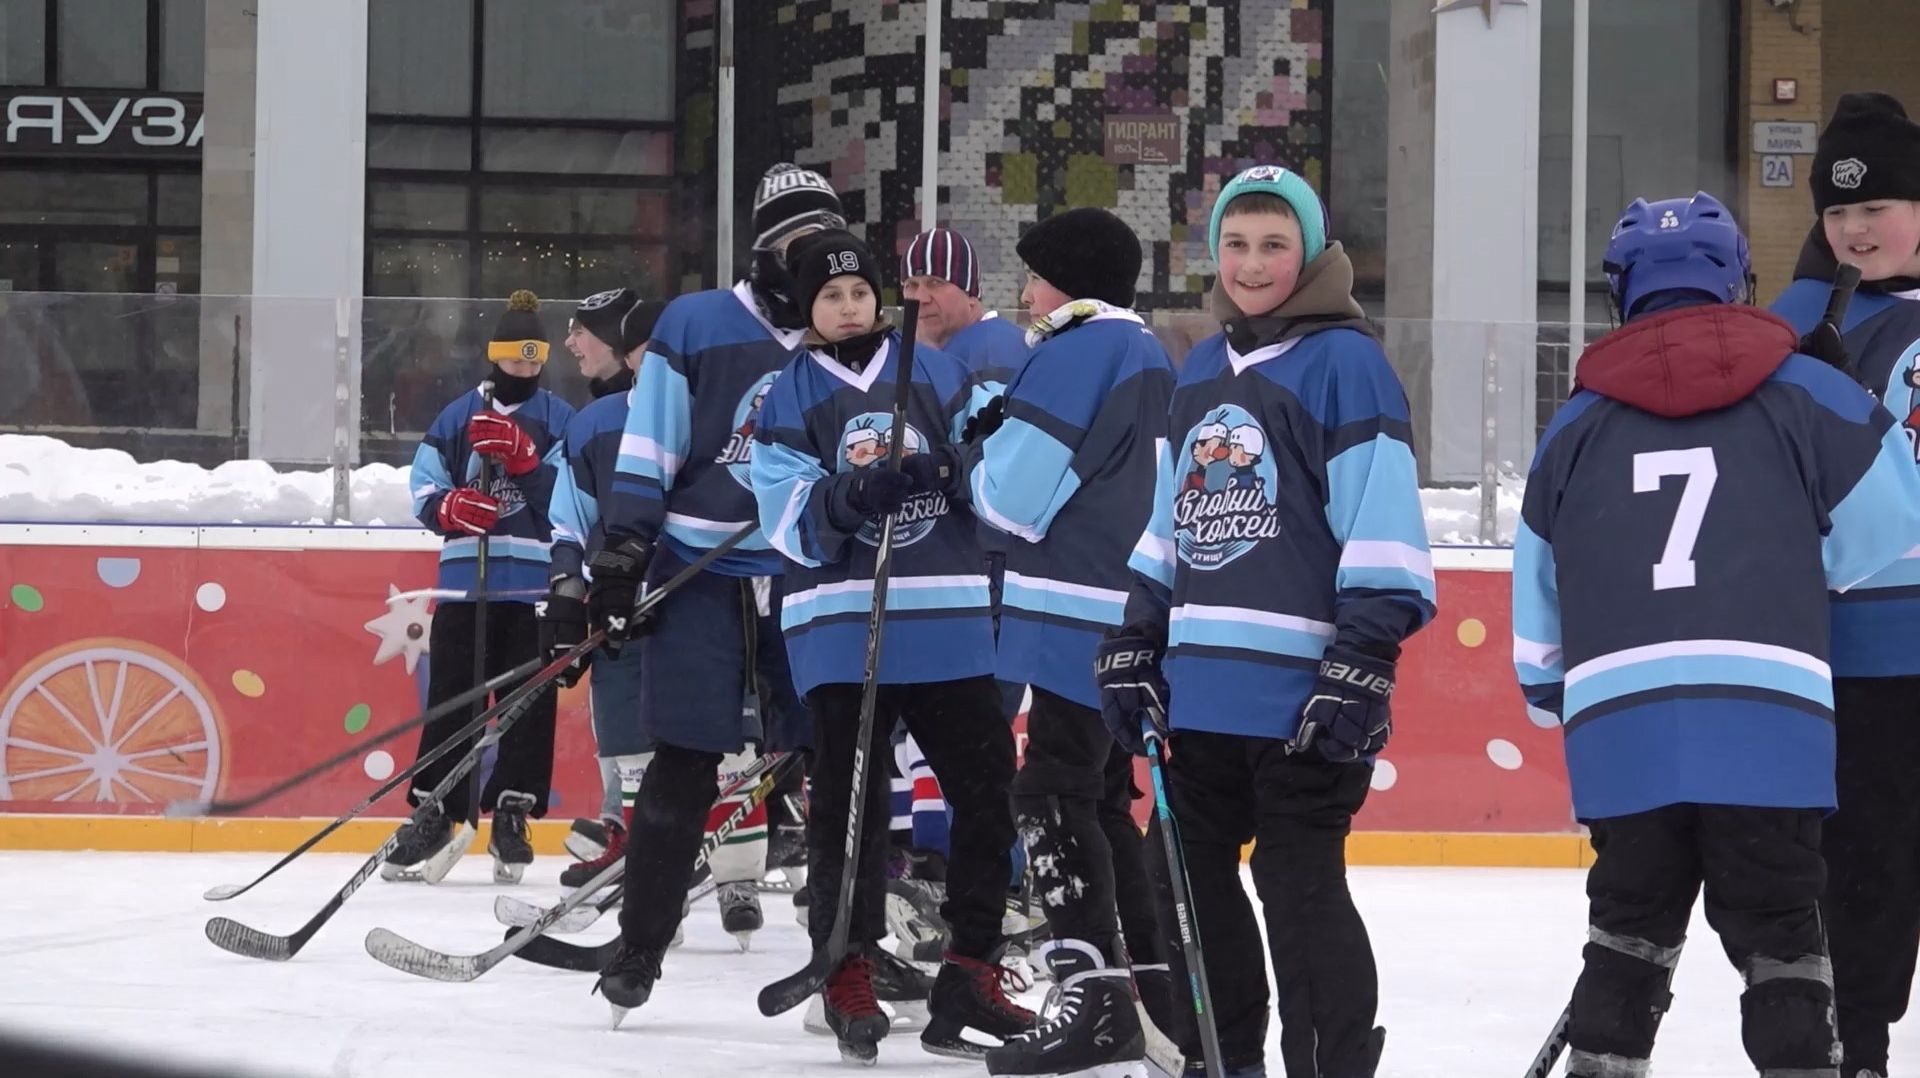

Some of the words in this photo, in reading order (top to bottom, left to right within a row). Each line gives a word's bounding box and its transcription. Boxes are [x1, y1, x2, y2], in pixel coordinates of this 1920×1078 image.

[1107, 121, 1177, 140] ГИДРАНТ
[827, 251, 859, 275] 19
[1633, 447, 1718, 590] 7
